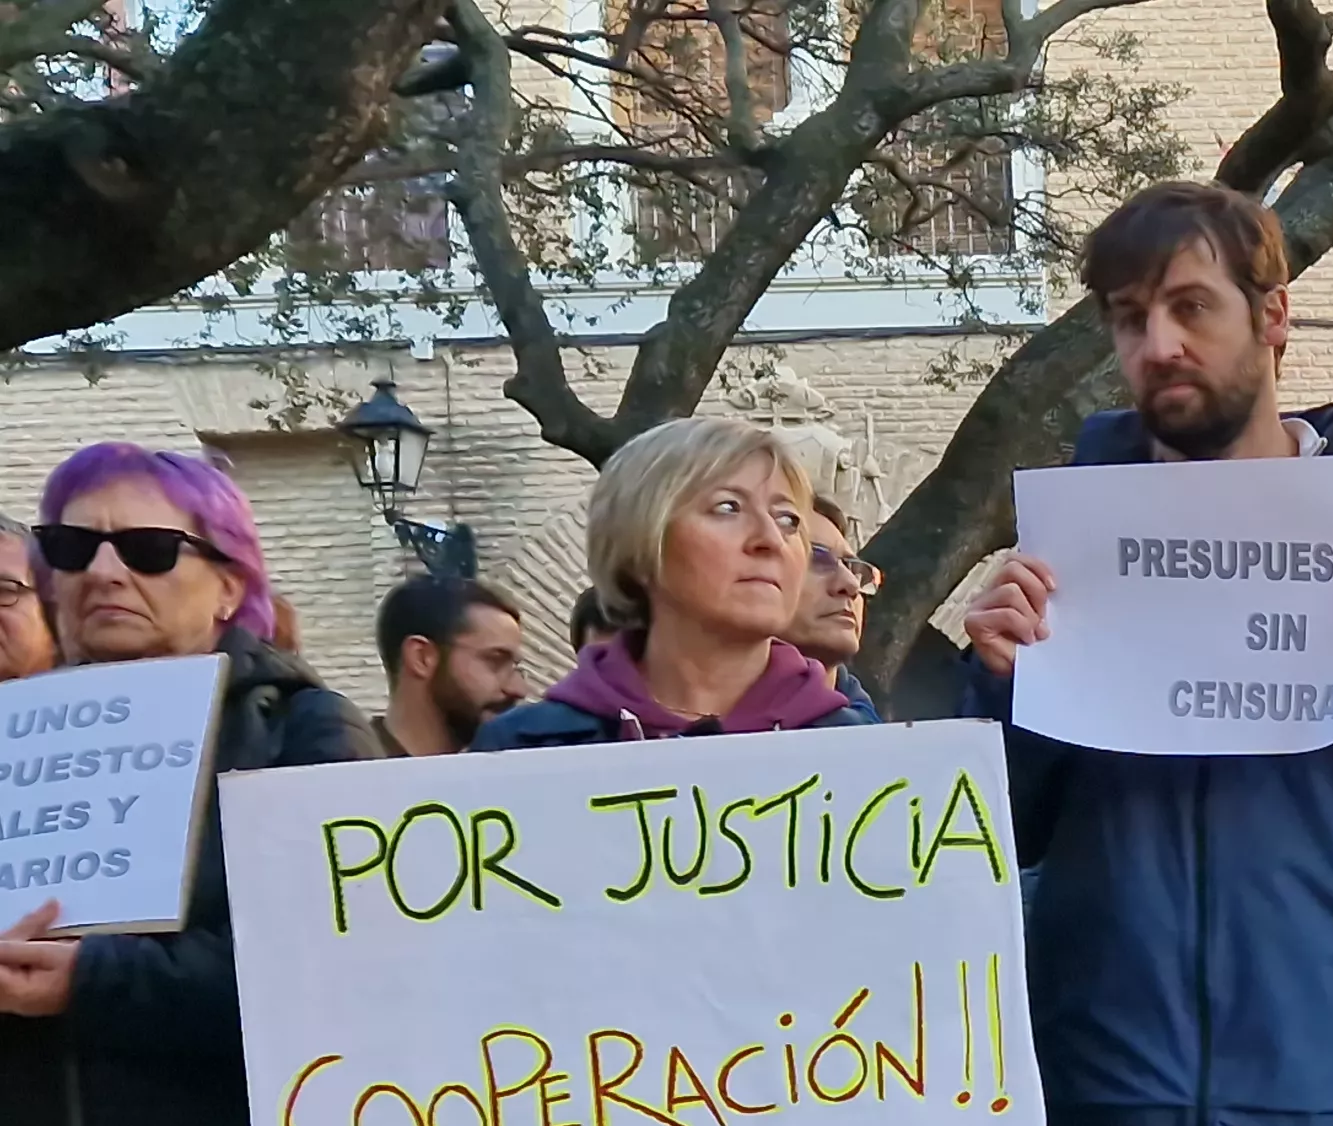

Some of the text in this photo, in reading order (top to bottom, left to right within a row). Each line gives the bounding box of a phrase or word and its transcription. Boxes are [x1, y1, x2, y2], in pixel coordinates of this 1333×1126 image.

[1245, 612, 1307, 652] SIN
[7, 696, 131, 738] UNOS
[0, 795, 140, 841] LES Y
[321, 768, 1009, 934] POR JUSTICIA
